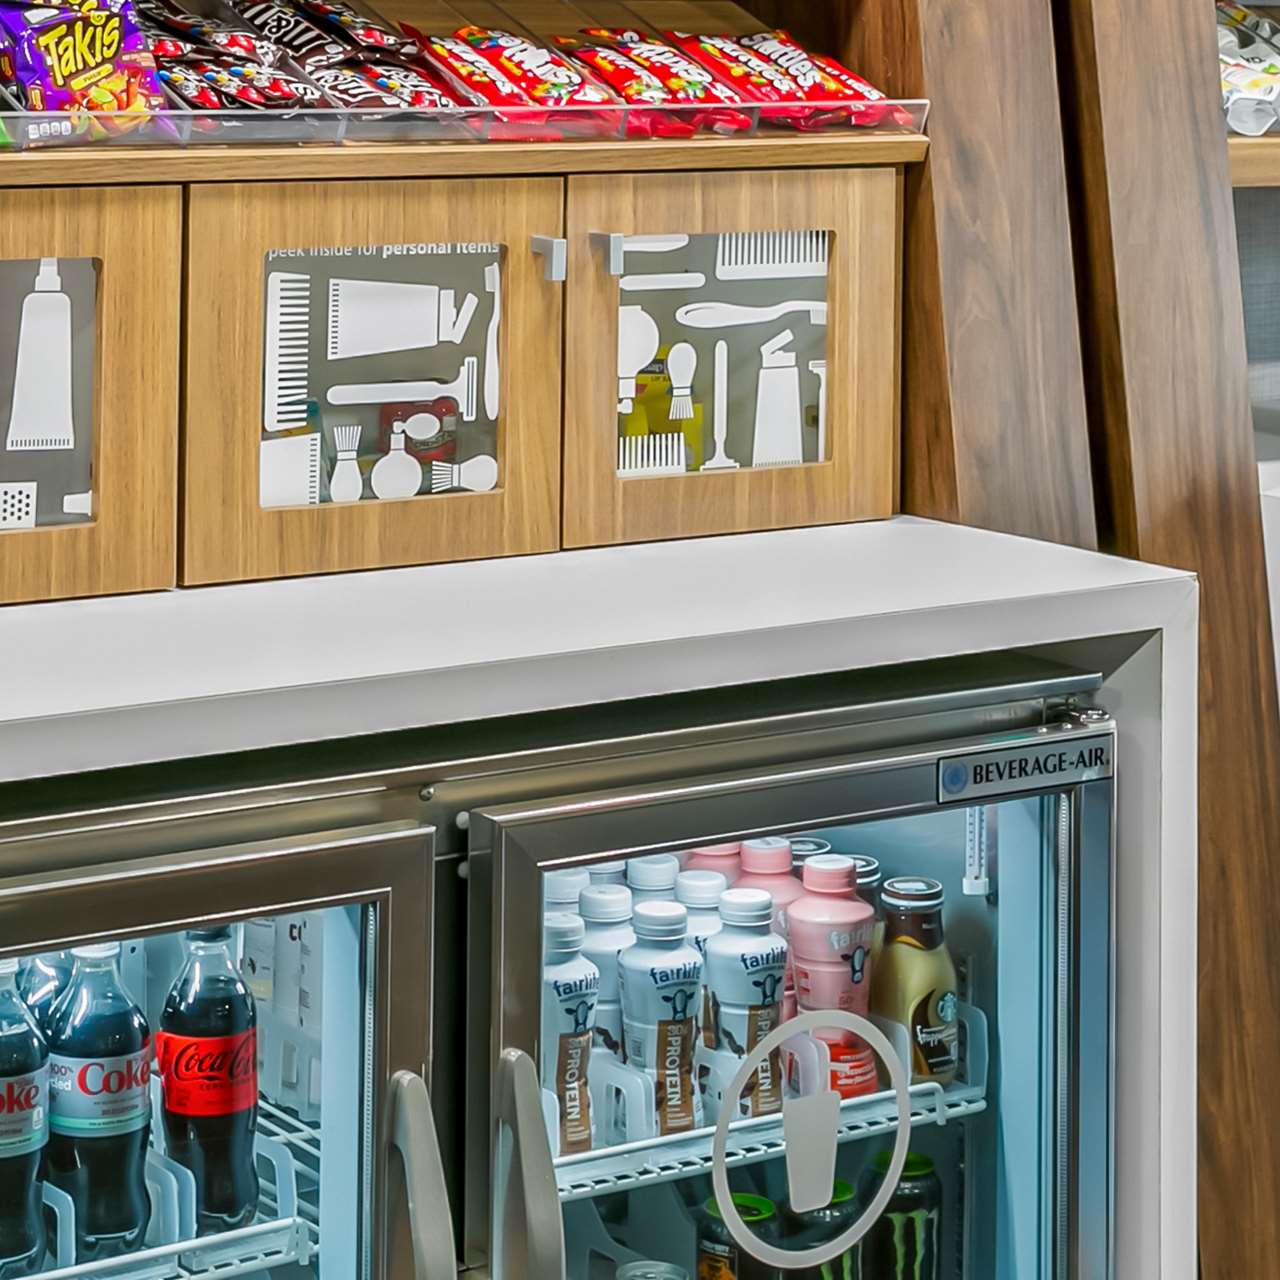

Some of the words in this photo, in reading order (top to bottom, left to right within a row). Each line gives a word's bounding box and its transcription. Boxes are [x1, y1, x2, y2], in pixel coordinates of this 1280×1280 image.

[38, 12, 121, 87] Takis
[740, 32, 821, 89] Skittles
[381, 241, 452, 259] personal
[972, 747, 1105, 785] BEVERAGE-AIR
[740, 946, 788, 971] fairlif
[552, 974, 600, 998] fairlif
[77, 1061, 151, 1097] Coke
[564, 1047, 581, 1120] PROTEIN
[665, 1037, 681, 1105] PROTEIN
